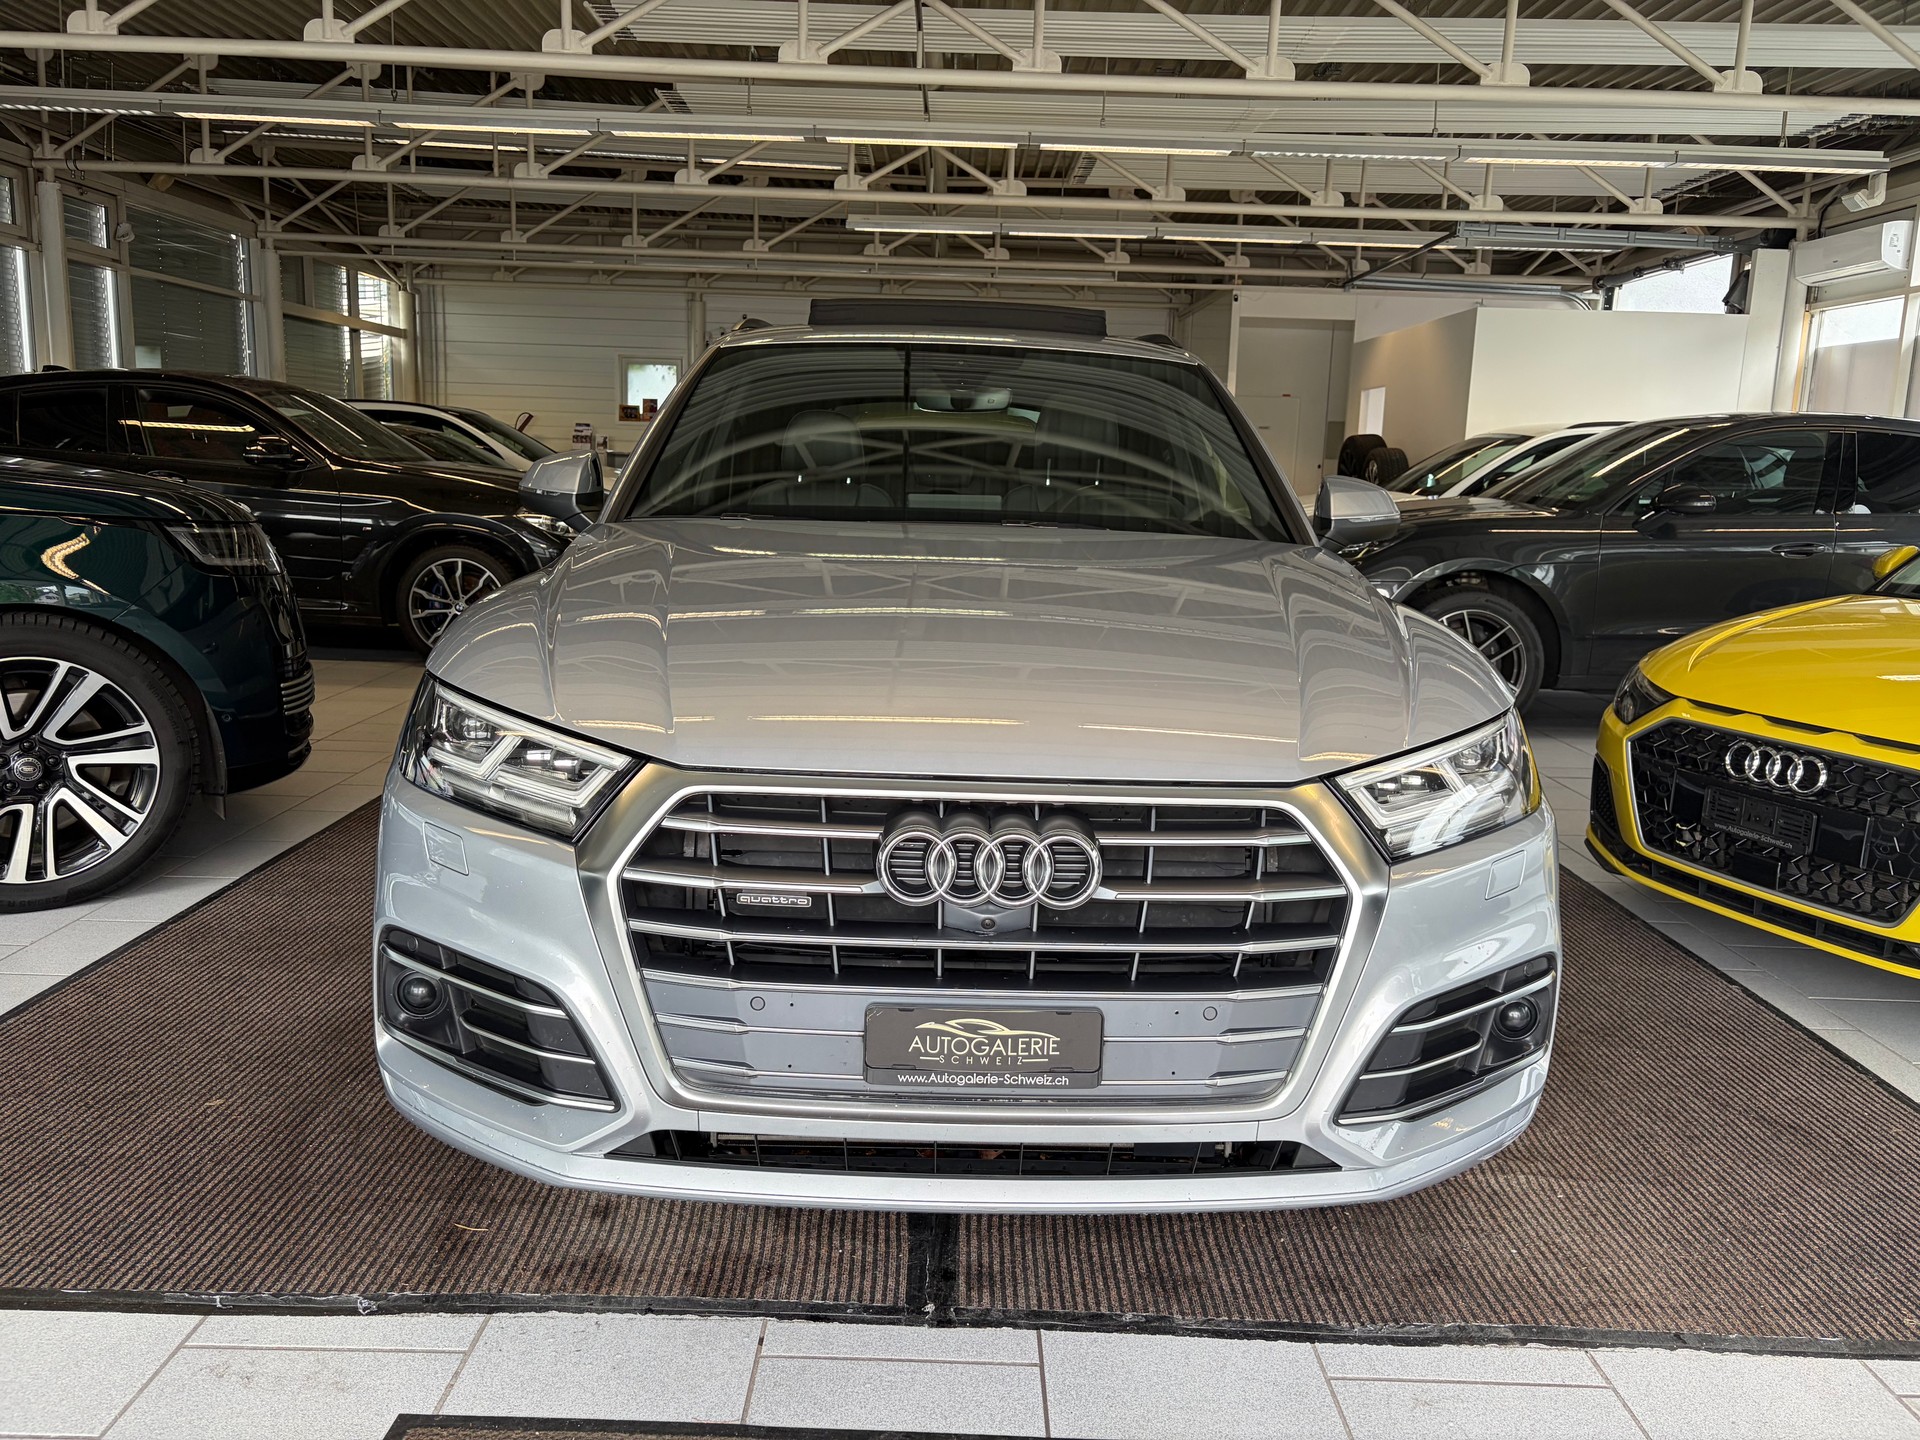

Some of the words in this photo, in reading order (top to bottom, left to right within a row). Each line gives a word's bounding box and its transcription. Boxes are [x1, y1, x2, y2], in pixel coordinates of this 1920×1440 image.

[740, 896, 808, 905] quattro
[908, 1036, 1061, 1056] AUTOGALERIE
[939, 1055, 1023, 1065] SCHWEIZ
[897, 1072, 1069, 1086] www.Autogalerie-Schweiz.ch
